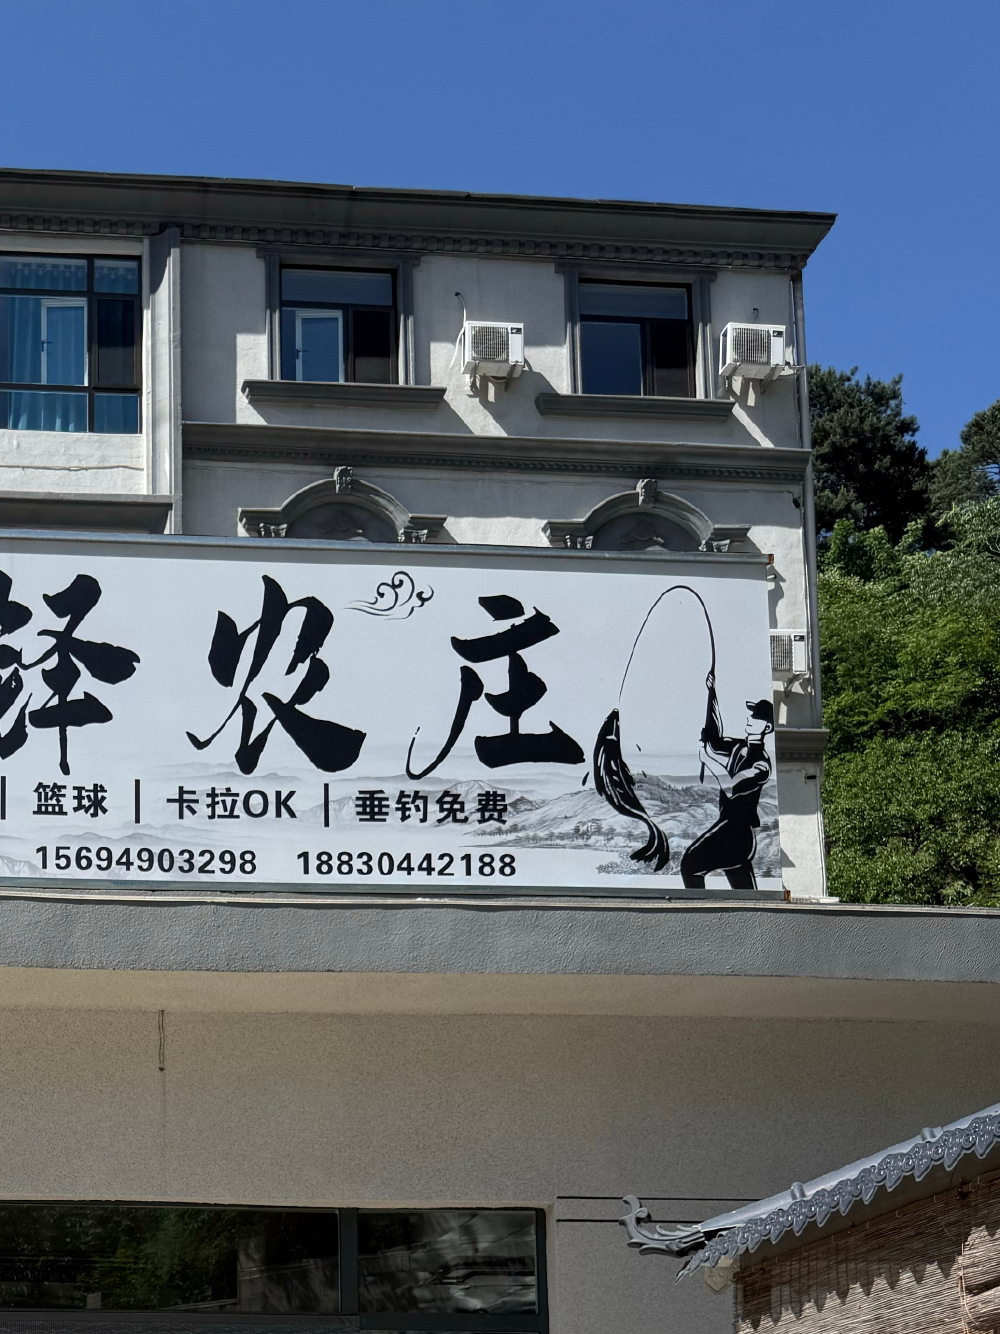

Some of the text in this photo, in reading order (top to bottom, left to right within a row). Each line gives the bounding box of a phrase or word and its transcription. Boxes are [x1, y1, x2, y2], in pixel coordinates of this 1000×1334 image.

[32, 781, 109, 818] 篮球
[166, 786, 298, 820] 卡拉OK
[354, 790, 509, 826] 垂钓免费
[36, 846, 258, 875] 15694903298
[297, 852, 516, 877] 18830442188
